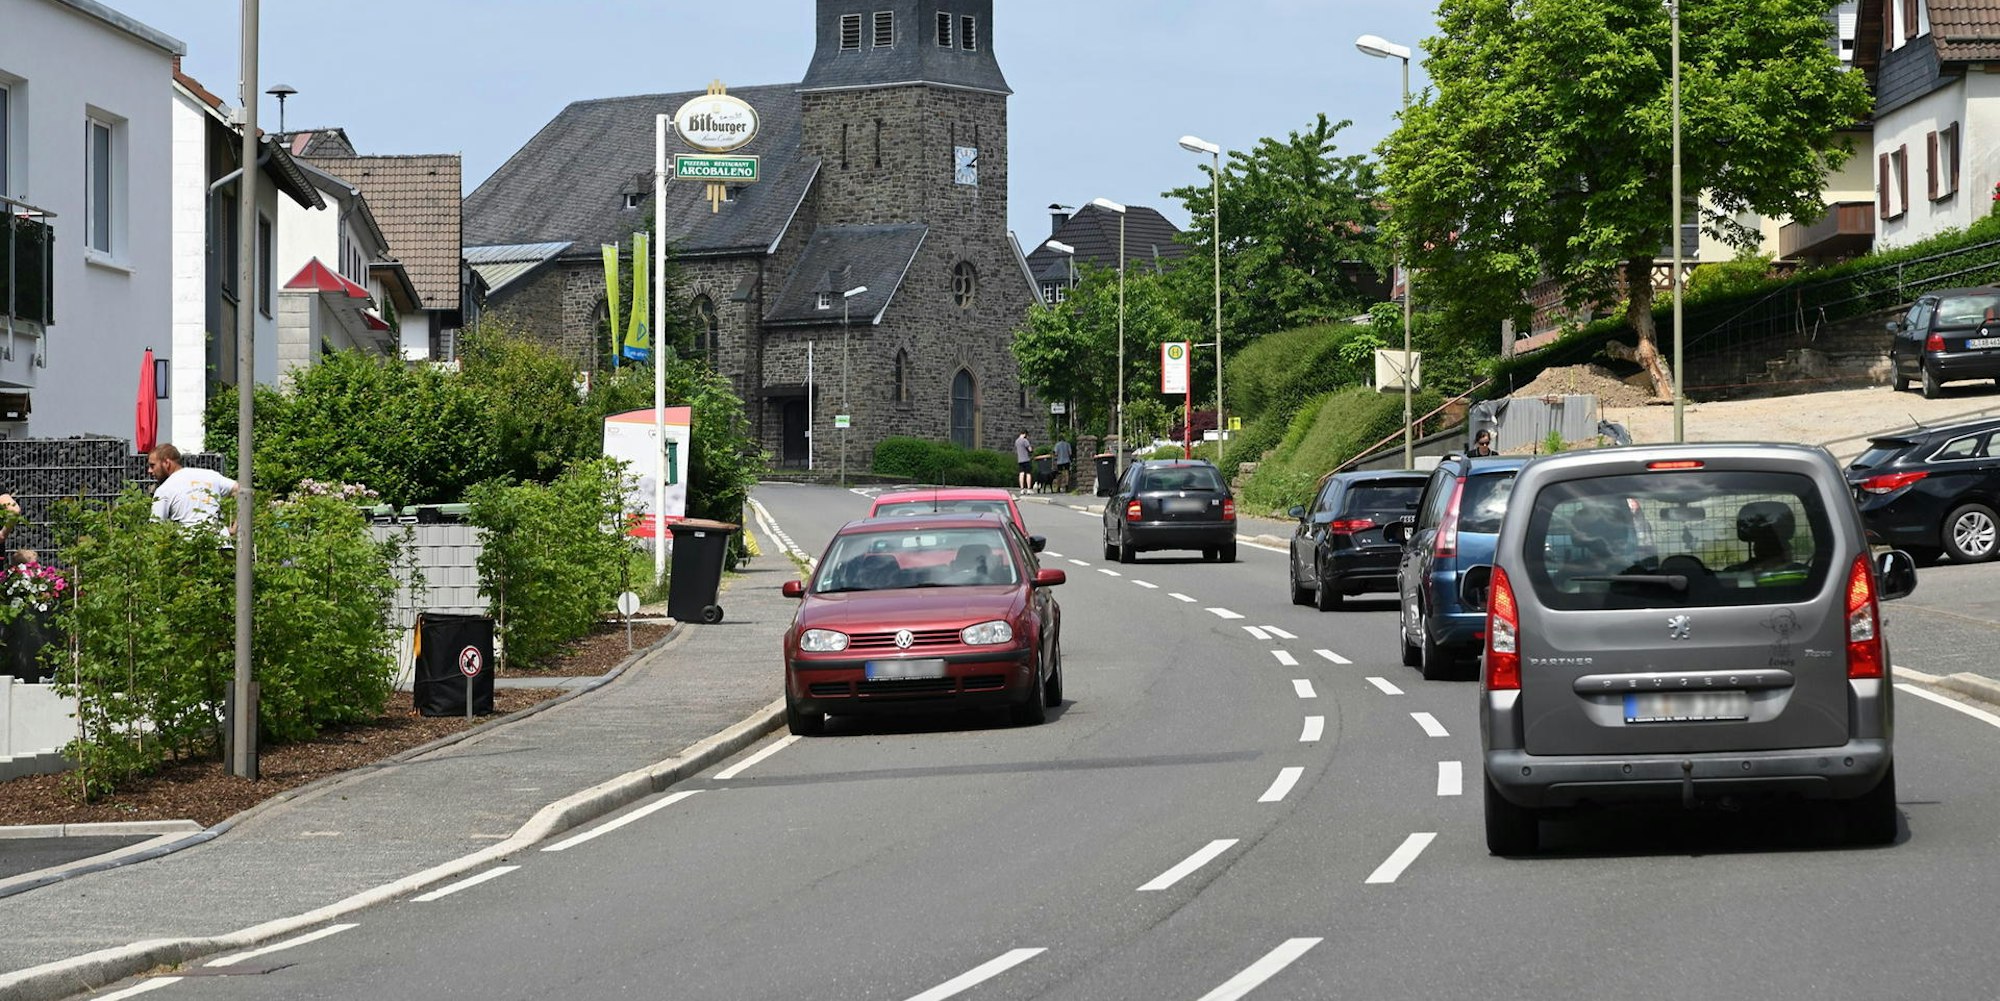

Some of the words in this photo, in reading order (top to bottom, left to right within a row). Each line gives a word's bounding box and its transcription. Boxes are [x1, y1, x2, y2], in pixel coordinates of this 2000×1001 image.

[688, 112, 747, 134] Bitburger
[680, 166, 753, 176] ARCOBALENO
[1529, 657, 1594, 666] PARTNER
[1602, 675, 1764, 689] PEUGEOT
